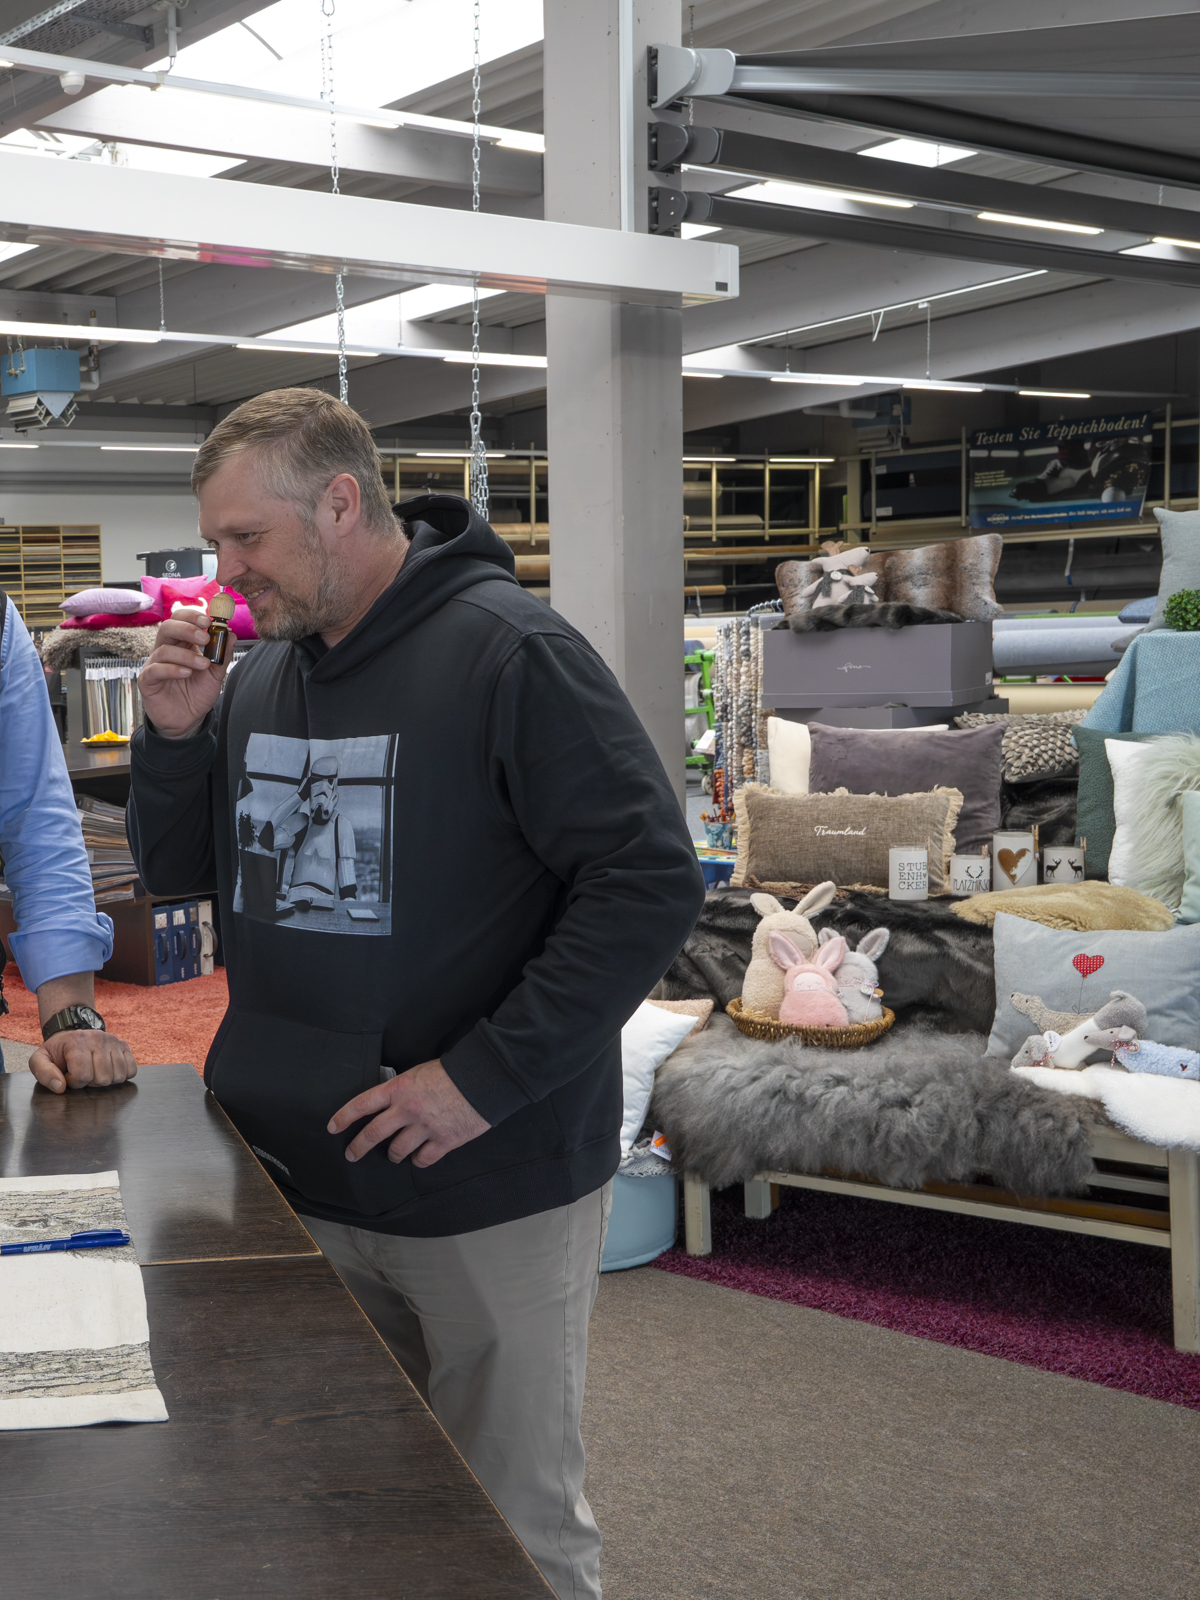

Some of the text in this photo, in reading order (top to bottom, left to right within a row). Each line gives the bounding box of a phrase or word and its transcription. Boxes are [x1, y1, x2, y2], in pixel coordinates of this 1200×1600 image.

[975, 414, 1148, 446] Testen Sie Teppichboden!
[814, 825, 867, 836] Traumland
[898, 862, 927, 872] STUB
[897, 881, 927, 890] CKER
